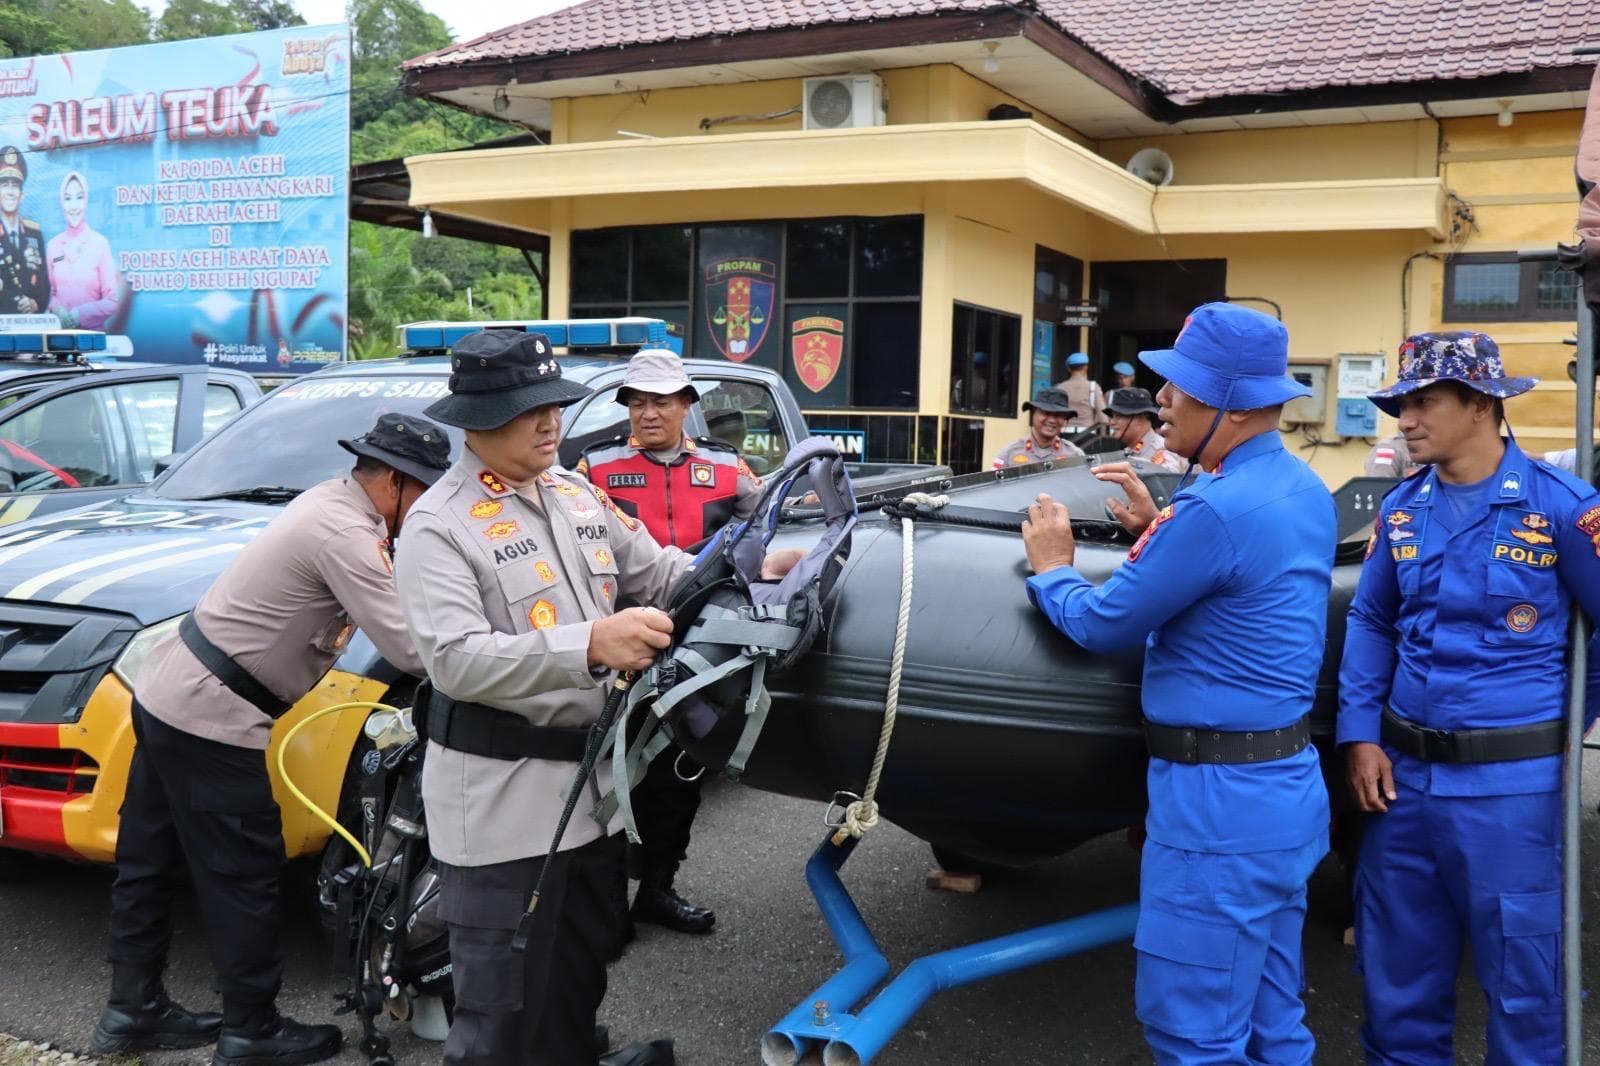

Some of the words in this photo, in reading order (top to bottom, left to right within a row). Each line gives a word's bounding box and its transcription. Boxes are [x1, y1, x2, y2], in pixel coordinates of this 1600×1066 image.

[26, 92, 157, 149] SALEUM
[161, 84, 279, 141] TEUKA
[160, 158, 235, 179] KAPOLDA
[238, 155, 285, 176] ACEH
[116, 185, 152, 206] DAN
[155, 182, 208, 202] KETUA
[210, 176, 334, 200] BHAYANGKARI
[163, 205, 232, 226] DAERAH
[236, 203, 280, 223] ACEH
[209, 226, 232, 246] DI
[120, 252, 176, 270] POLRES
[179, 250, 224, 268] ACEH
[229, 249, 280, 267] BARAT
[284, 248, 330, 266] DAYA
[716, 260, 762, 273] PROPAM
[187, 270, 248, 289] BREUEH
[218, 343, 239, 354] Polri
[240, 343, 267, 354] Untuk
[218, 352, 268, 364] Masyarakat
[293, 381, 380, 400] KORPS
[610, 475, 645, 486] FERRY
[494, 538, 539, 565] AGUS
[1493, 544, 1559, 567] POLRI
